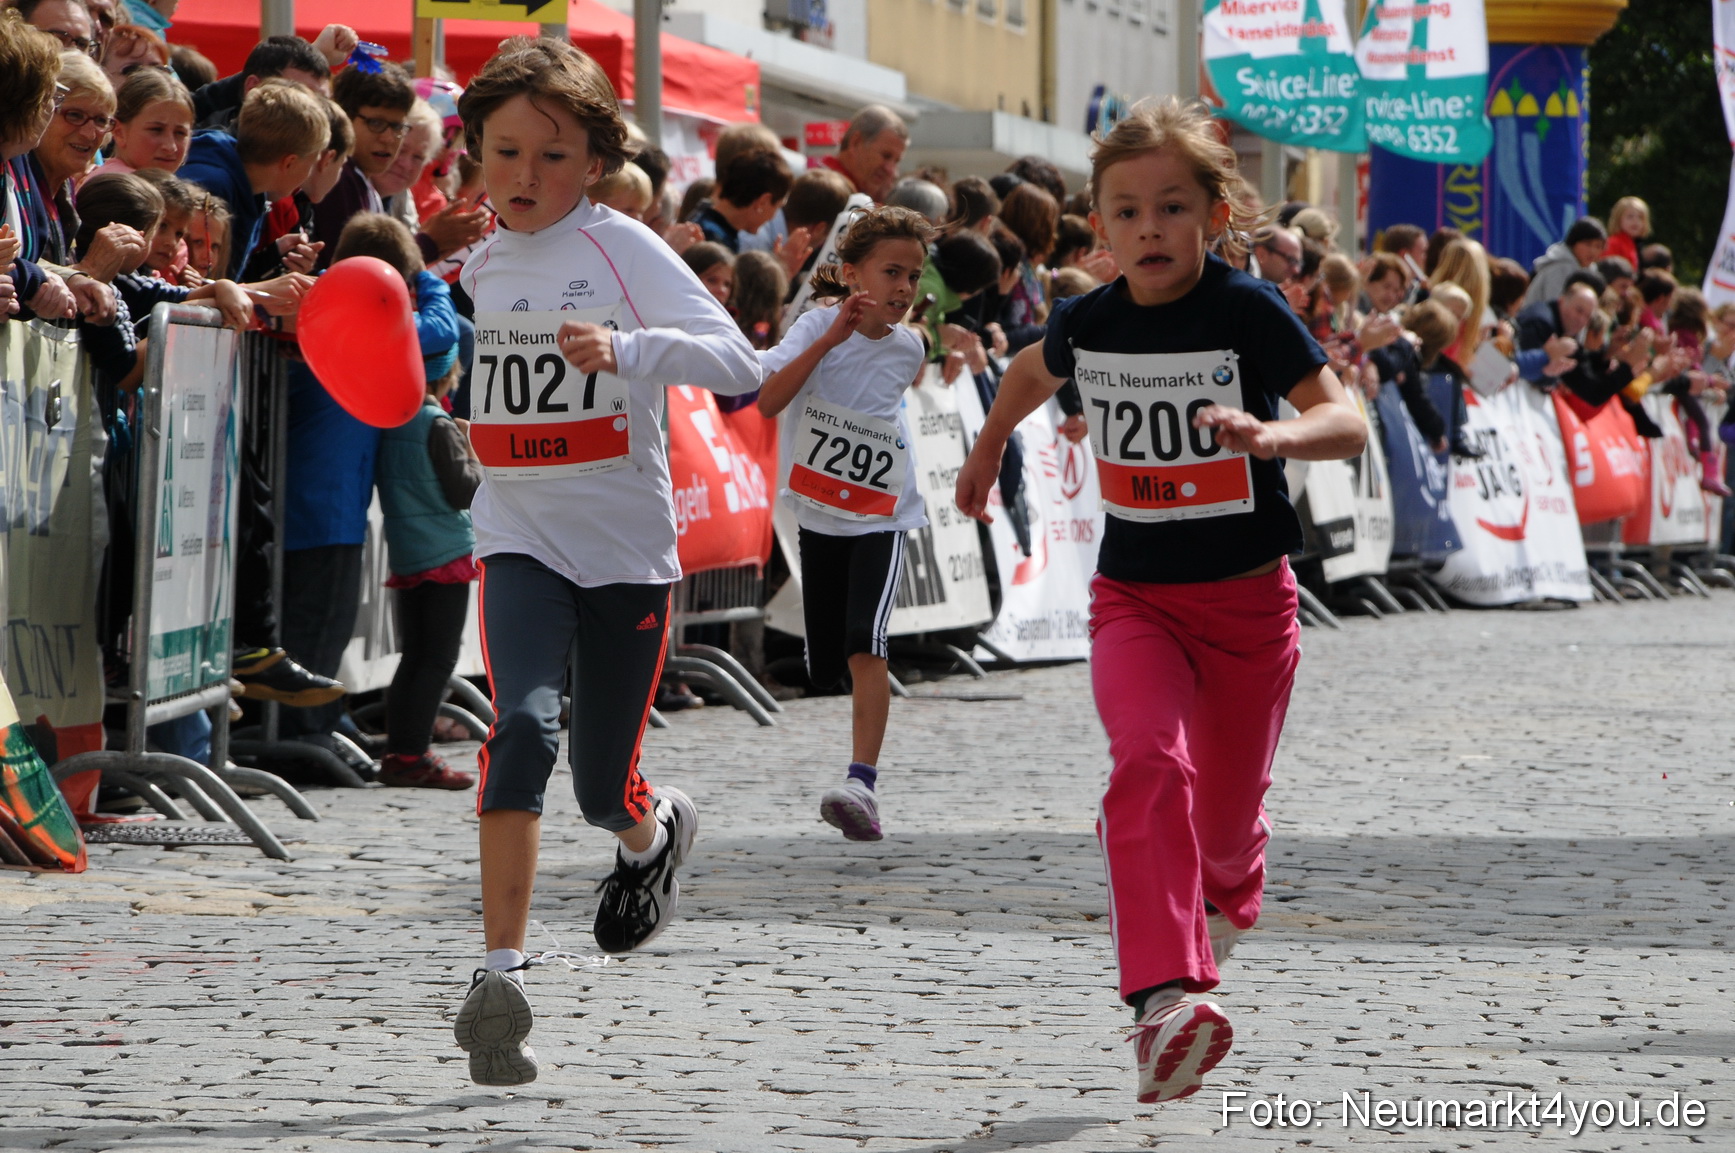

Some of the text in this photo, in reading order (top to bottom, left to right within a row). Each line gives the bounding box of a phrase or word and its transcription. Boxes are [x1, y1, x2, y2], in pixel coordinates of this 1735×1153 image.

[1407, 124, 1460, 154] 6352
[562, 290, 595, 298] Kalenji
[509, 329, 558, 345] Neum
[1077, 367, 1204, 388] PARTL Neumarkt
[805, 406, 839, 427] PARTL
[842, 420, 893, 444] Neumarkt
[510, 433, 568, 459] Luca
[807, 427, 893, 489] 7292
[1132, 475, 1177, 501] Mia
